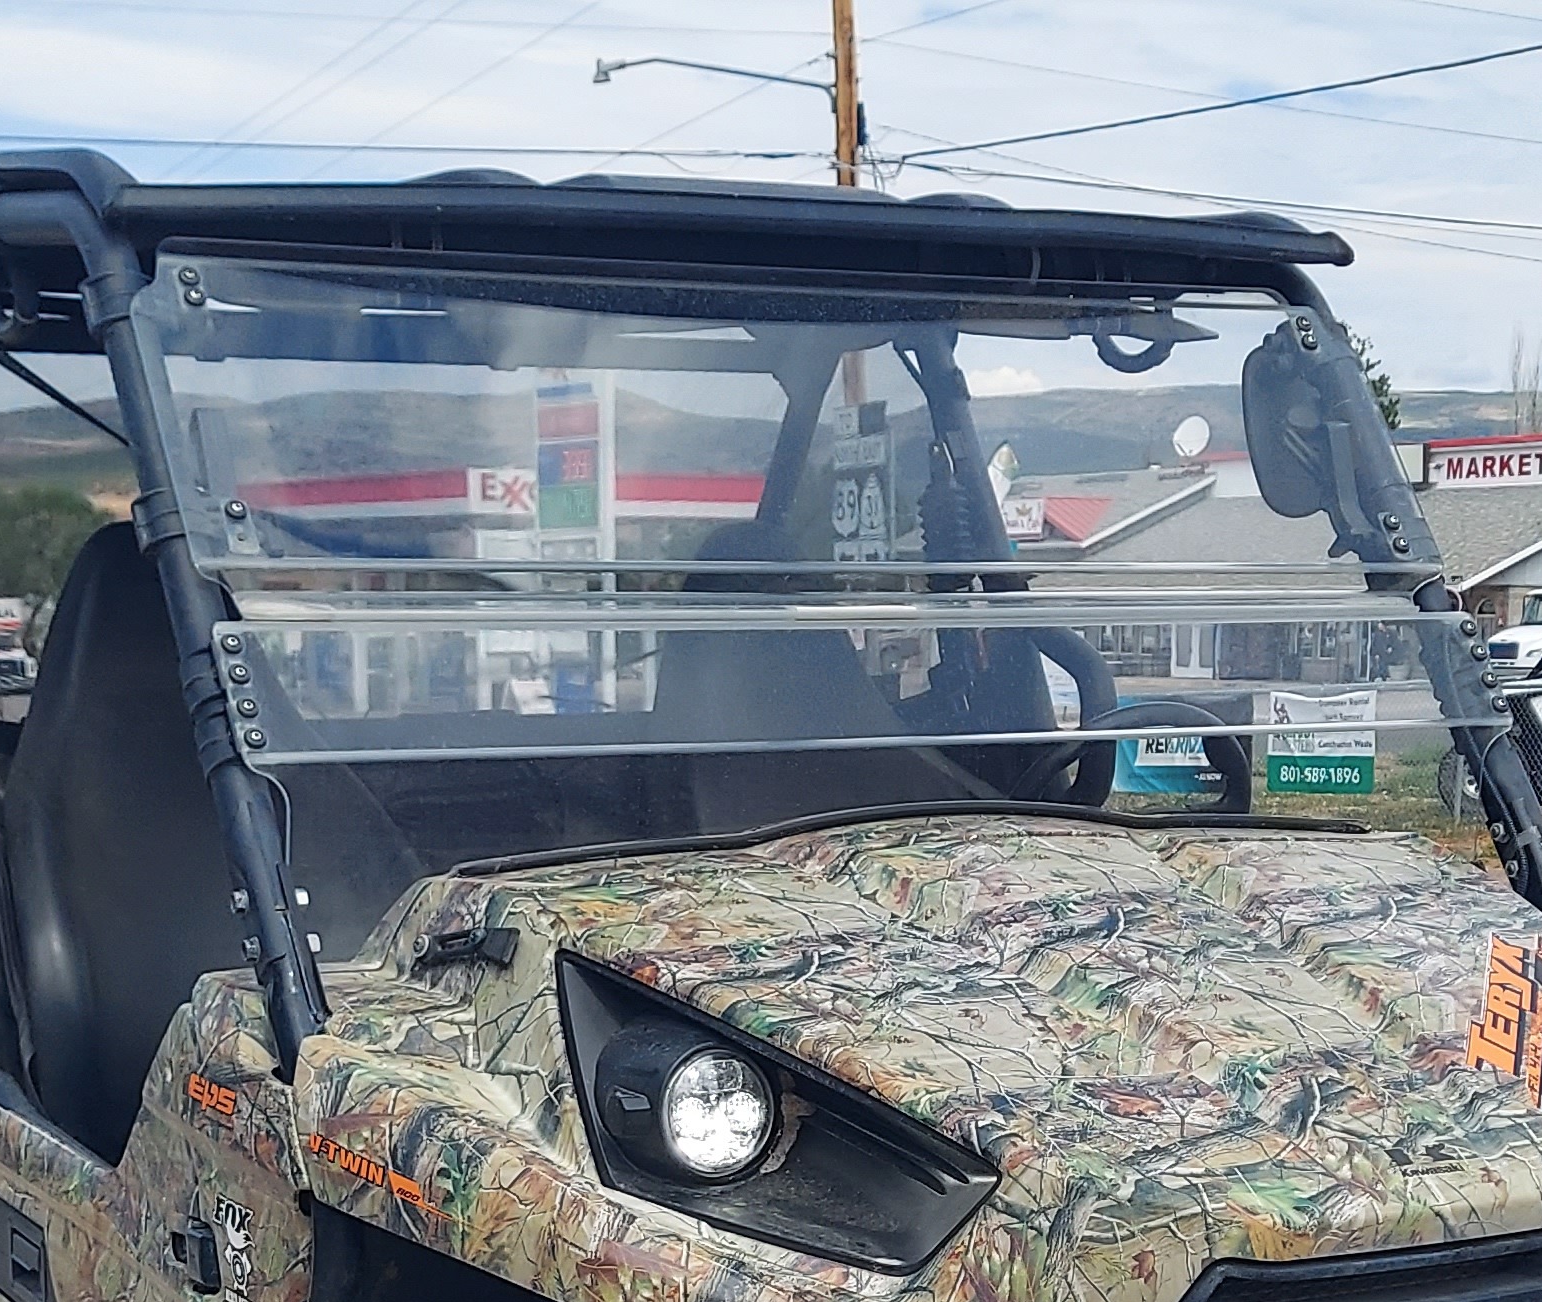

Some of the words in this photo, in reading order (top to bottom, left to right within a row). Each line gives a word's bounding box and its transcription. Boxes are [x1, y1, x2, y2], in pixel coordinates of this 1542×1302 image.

[1280, 764, 1361, 784] 801-589-1896
[1466, 931, 1536, 1076] TERYX
[309, 1131, 385, 1187] V-TWIN
[396, 1187, 421, 1202] 800
[213, 1193, 255, 1236] FOX
